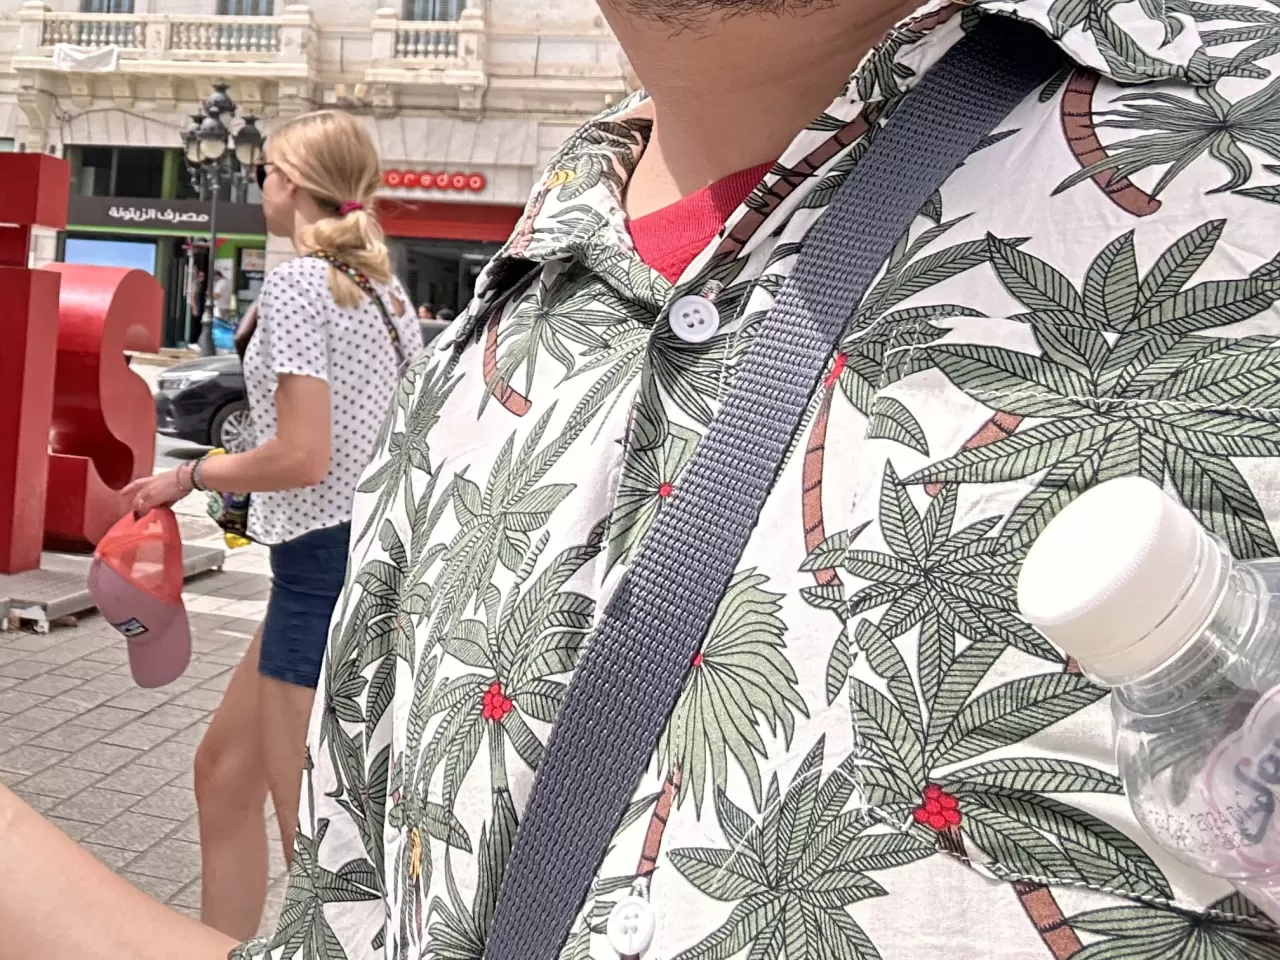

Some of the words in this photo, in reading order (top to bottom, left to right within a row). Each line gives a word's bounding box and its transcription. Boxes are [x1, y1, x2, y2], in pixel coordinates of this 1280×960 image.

[384, 170, 485, 192] oredoo
[107, 206, 157, 221] الزيتونة
[157, 208, 210, 223] مصرف
